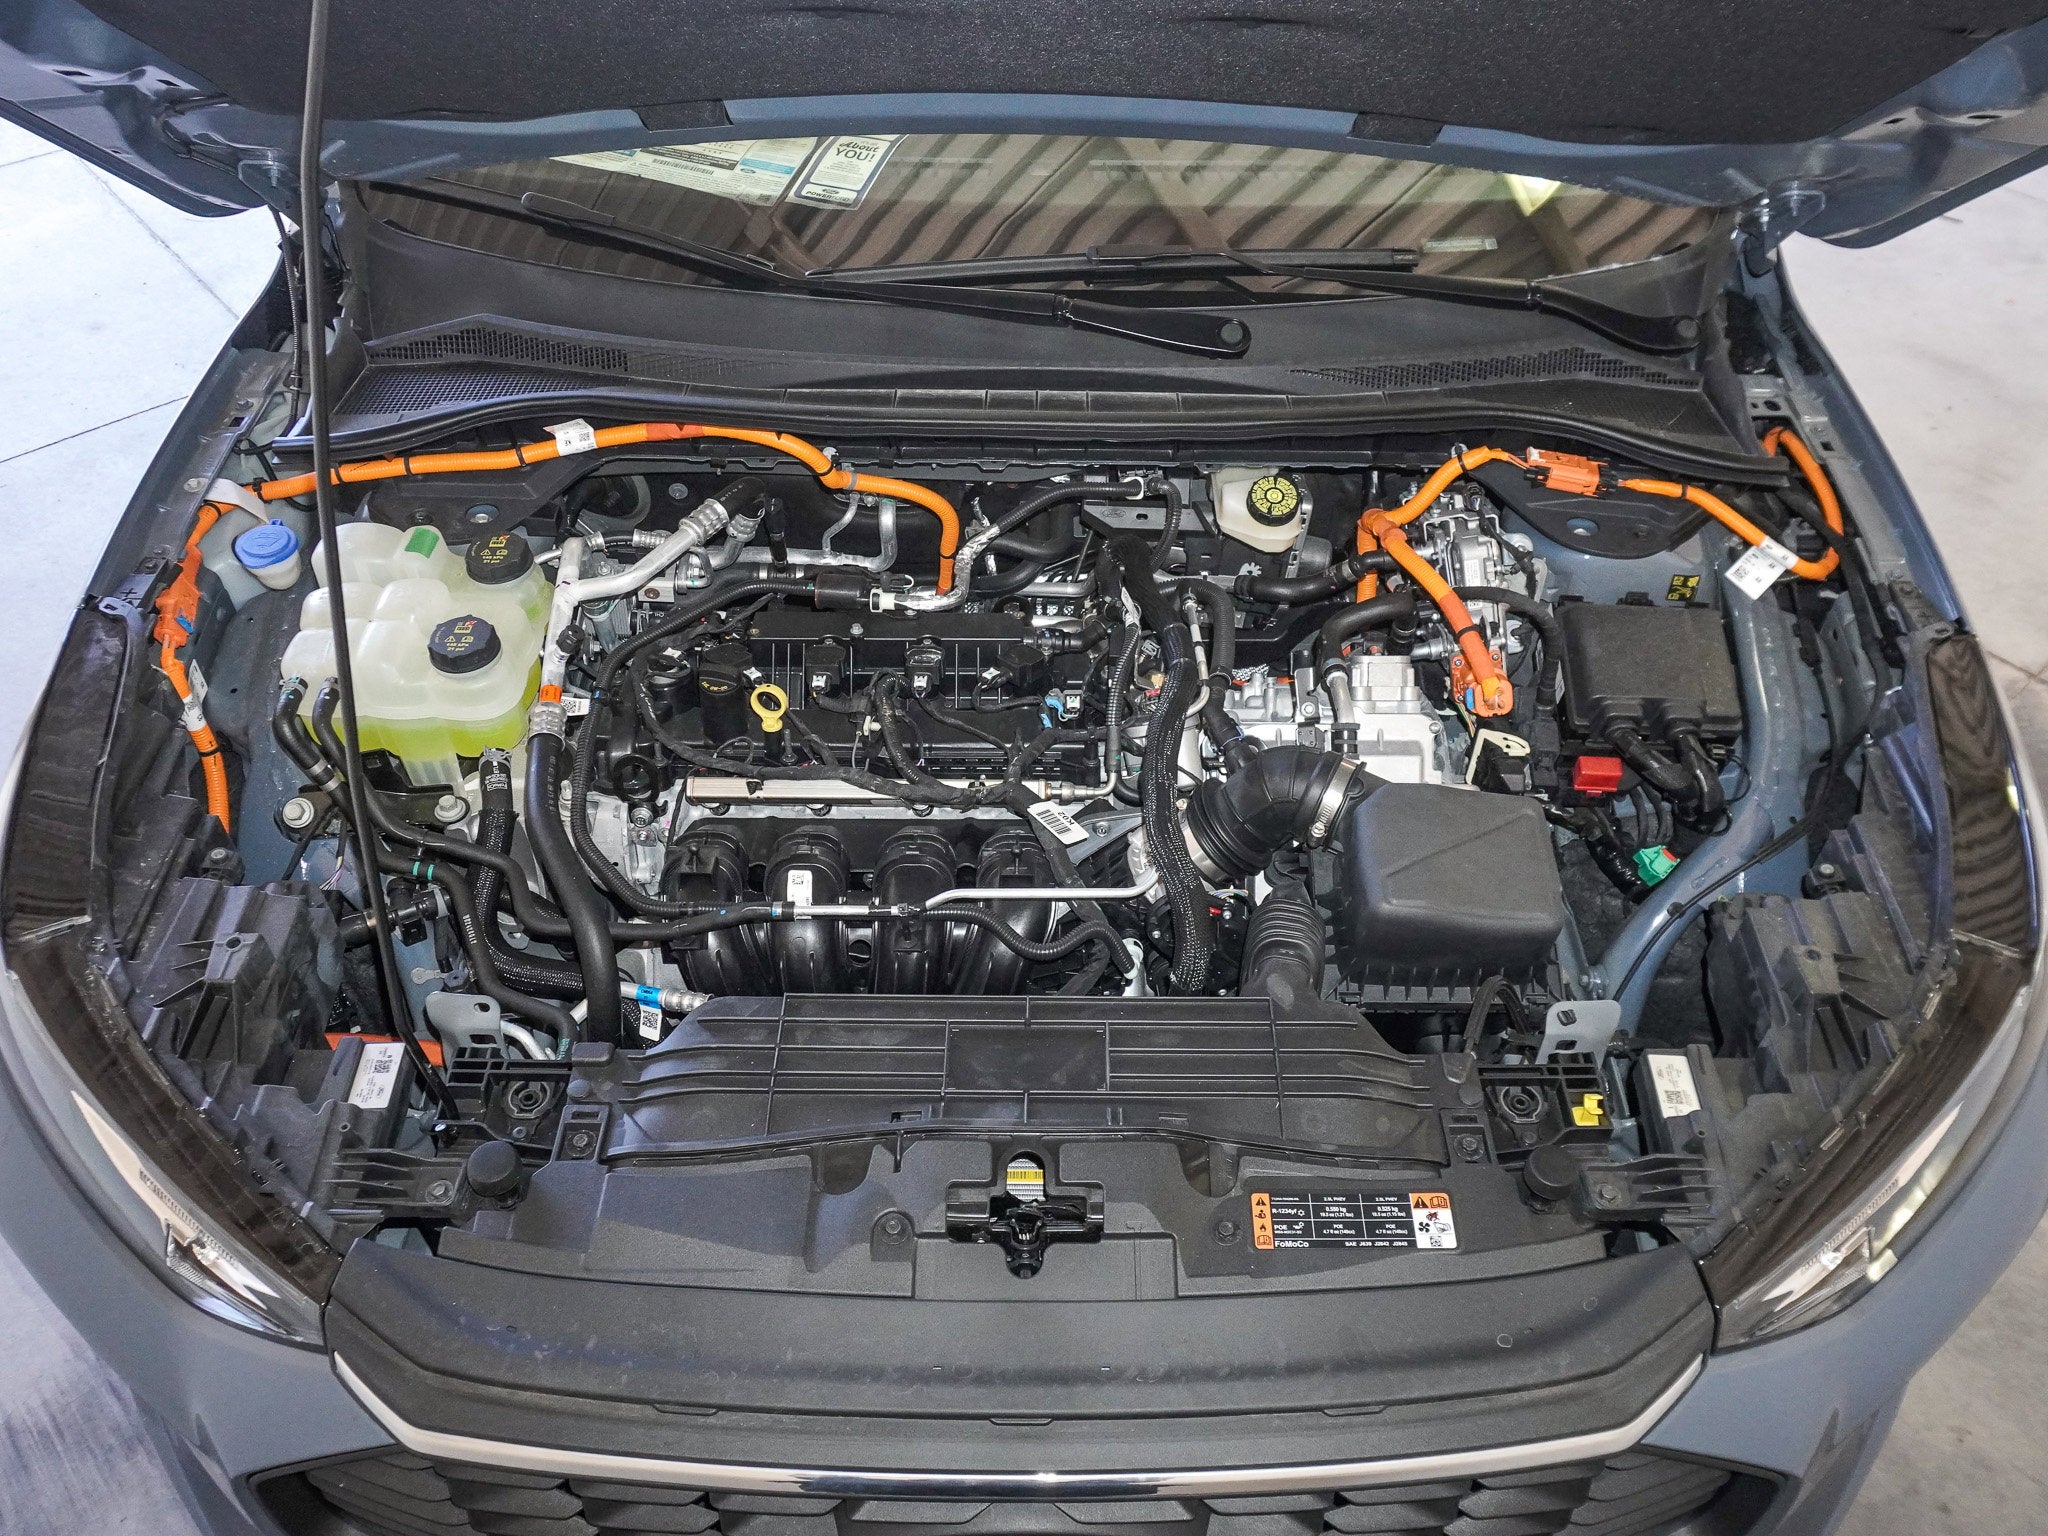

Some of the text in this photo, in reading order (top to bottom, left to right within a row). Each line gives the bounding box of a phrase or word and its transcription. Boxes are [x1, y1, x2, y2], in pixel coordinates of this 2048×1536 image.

[839, 141, 880, 153] About
[836, 147, 876, 162] YOU!
[1271, 1208, 1297, 1216] R-1234yf
[1274, 1240, 1310, 1248] FoMoCo
